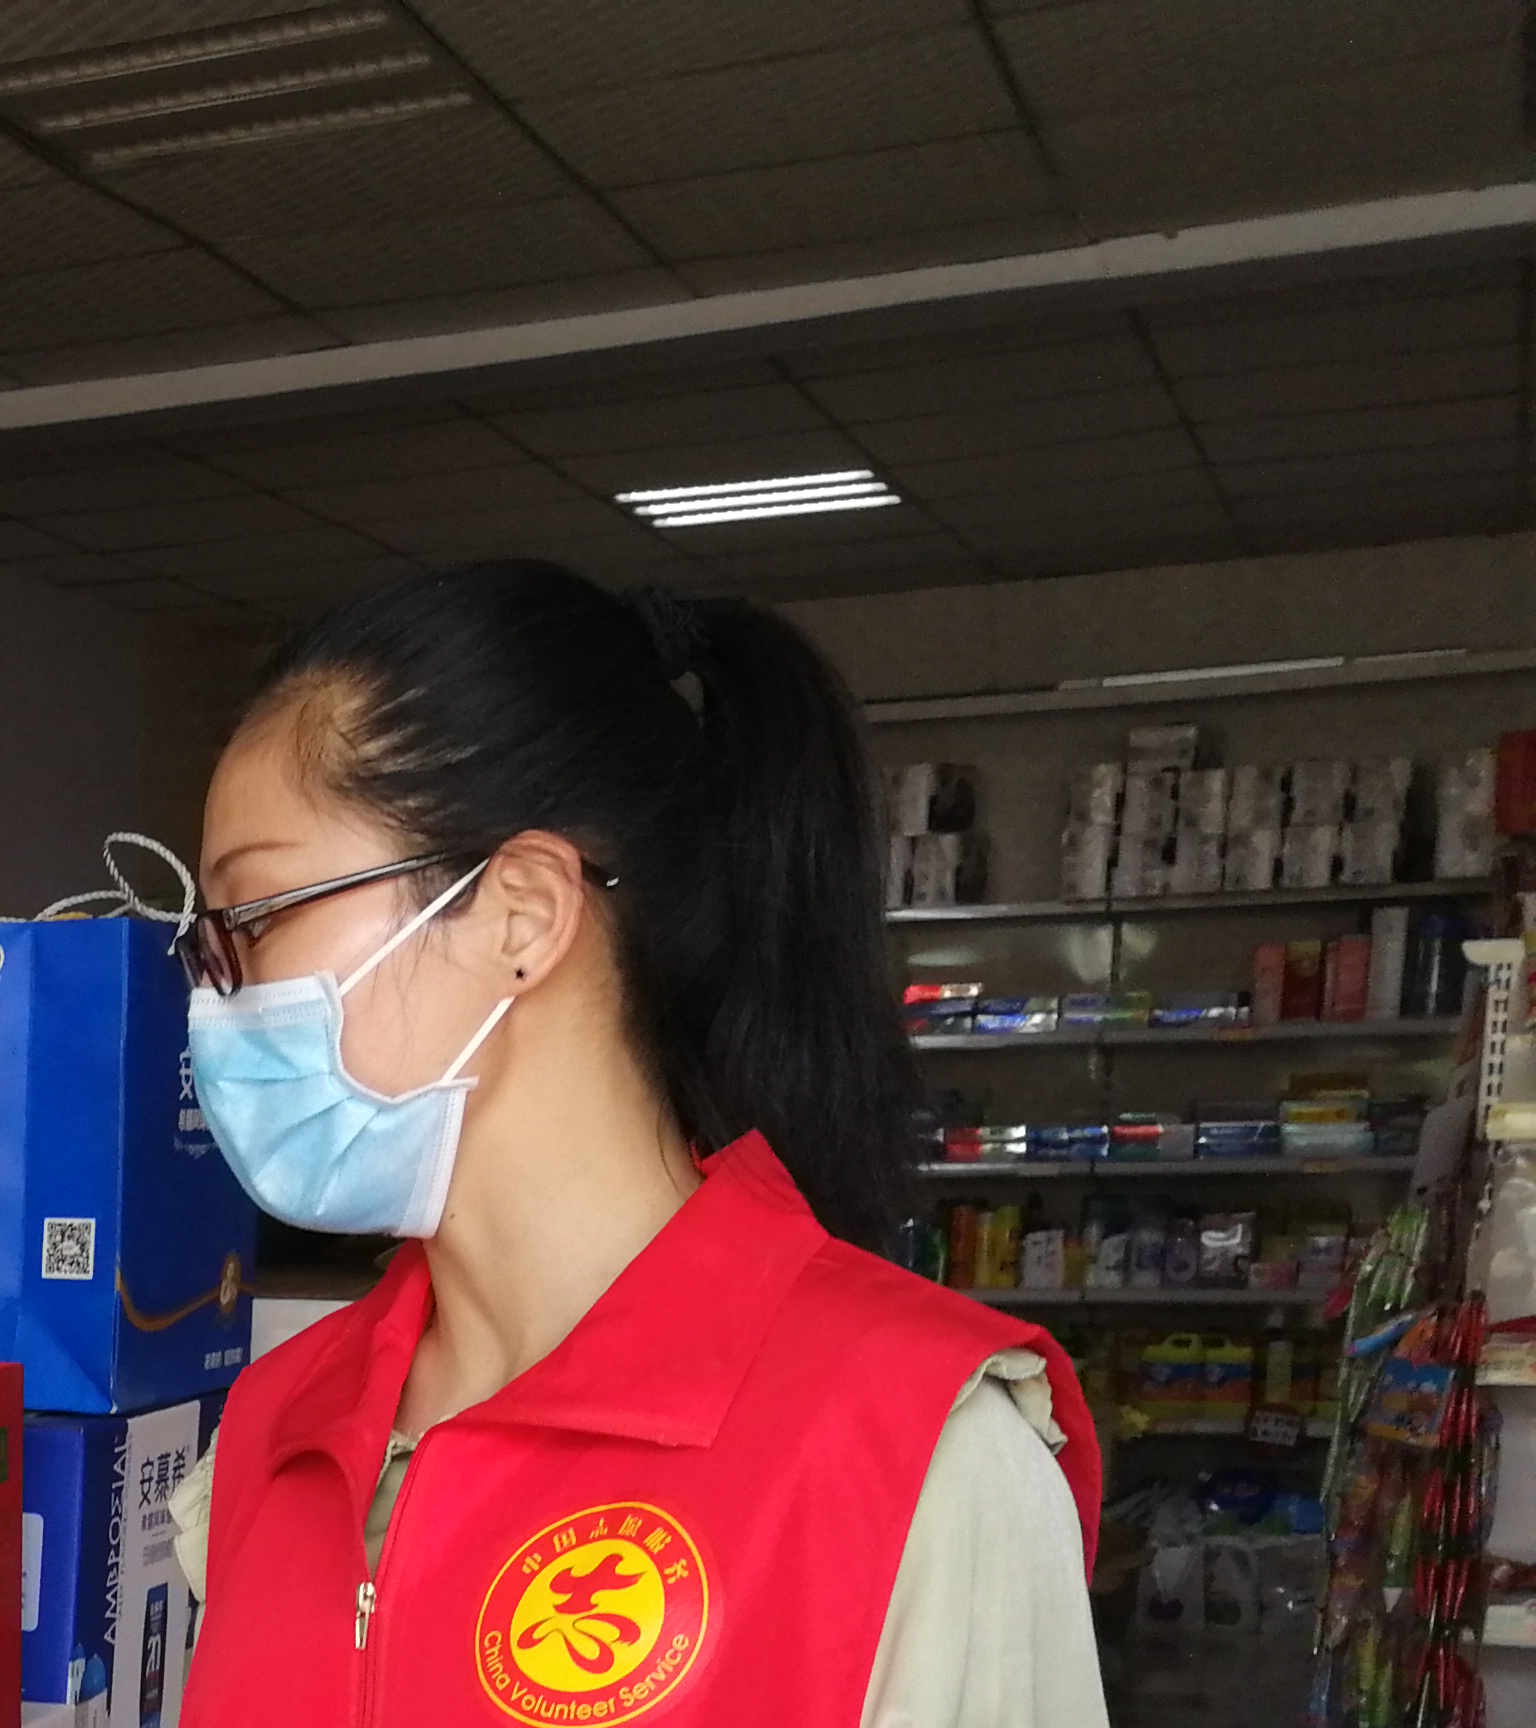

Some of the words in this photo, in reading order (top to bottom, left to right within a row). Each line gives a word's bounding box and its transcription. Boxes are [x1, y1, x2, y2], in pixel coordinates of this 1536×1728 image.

[138, 1446, 187, 1510] 安慕希
[483, 1629, 511, 1692] China
[509, 1680, 616, 1721] Volunteer
[617, 1633, 691, 1709] Service
